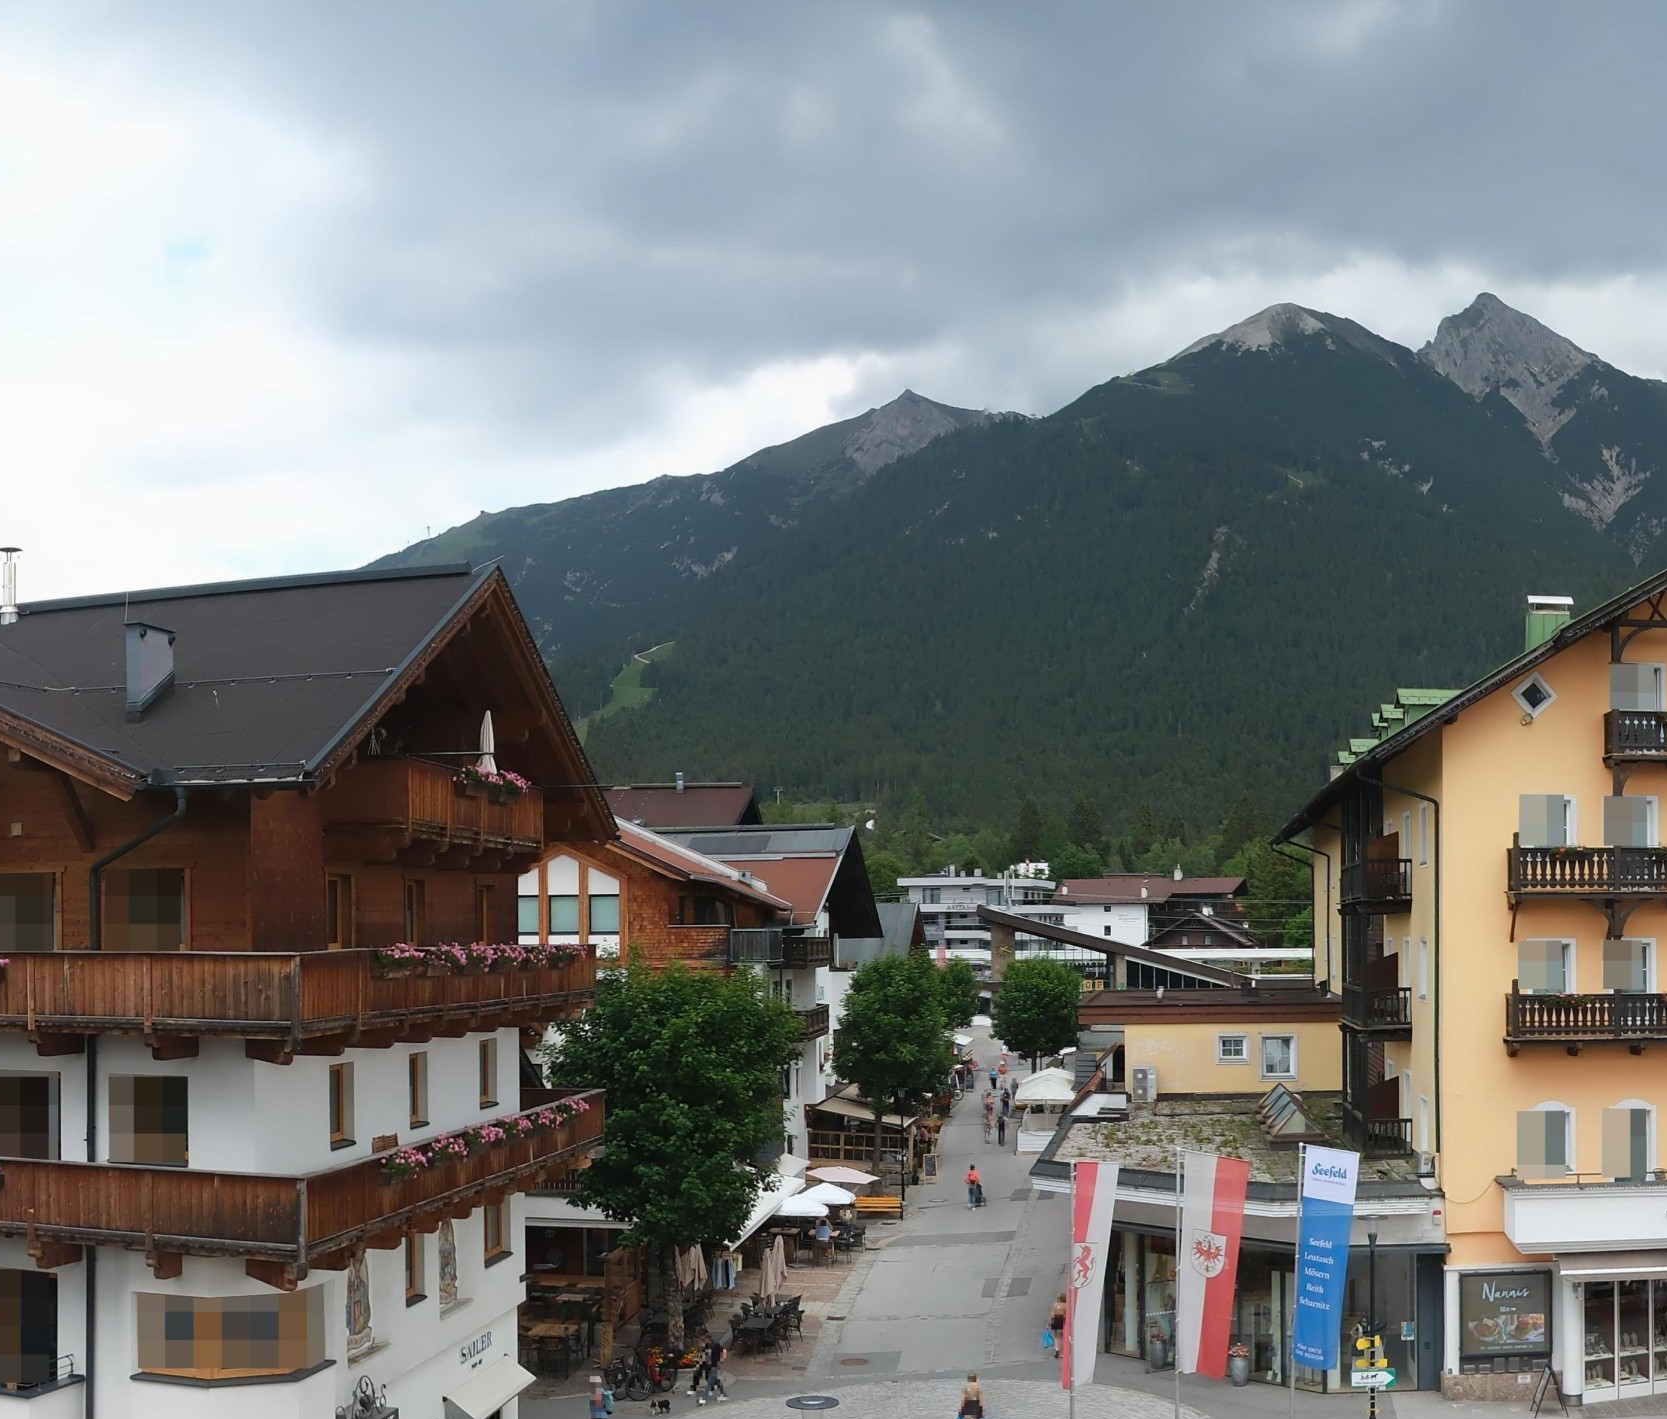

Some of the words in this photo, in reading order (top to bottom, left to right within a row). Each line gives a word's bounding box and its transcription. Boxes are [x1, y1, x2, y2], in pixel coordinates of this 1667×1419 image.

[1311, 1162, 1347, 1180] Seefeld
[1309, 1237, 1333, 1249] Seefeld
[1304, 1251, 1334, 1265] Leutasch
[1304, 1266, 1330, 1280] Mösern
[1306, 1282, 1324, 1294] Reith
[1299, 1295, 1331, 1311] Scharnitz
[460, 1331, 493, 1365] SAILER
